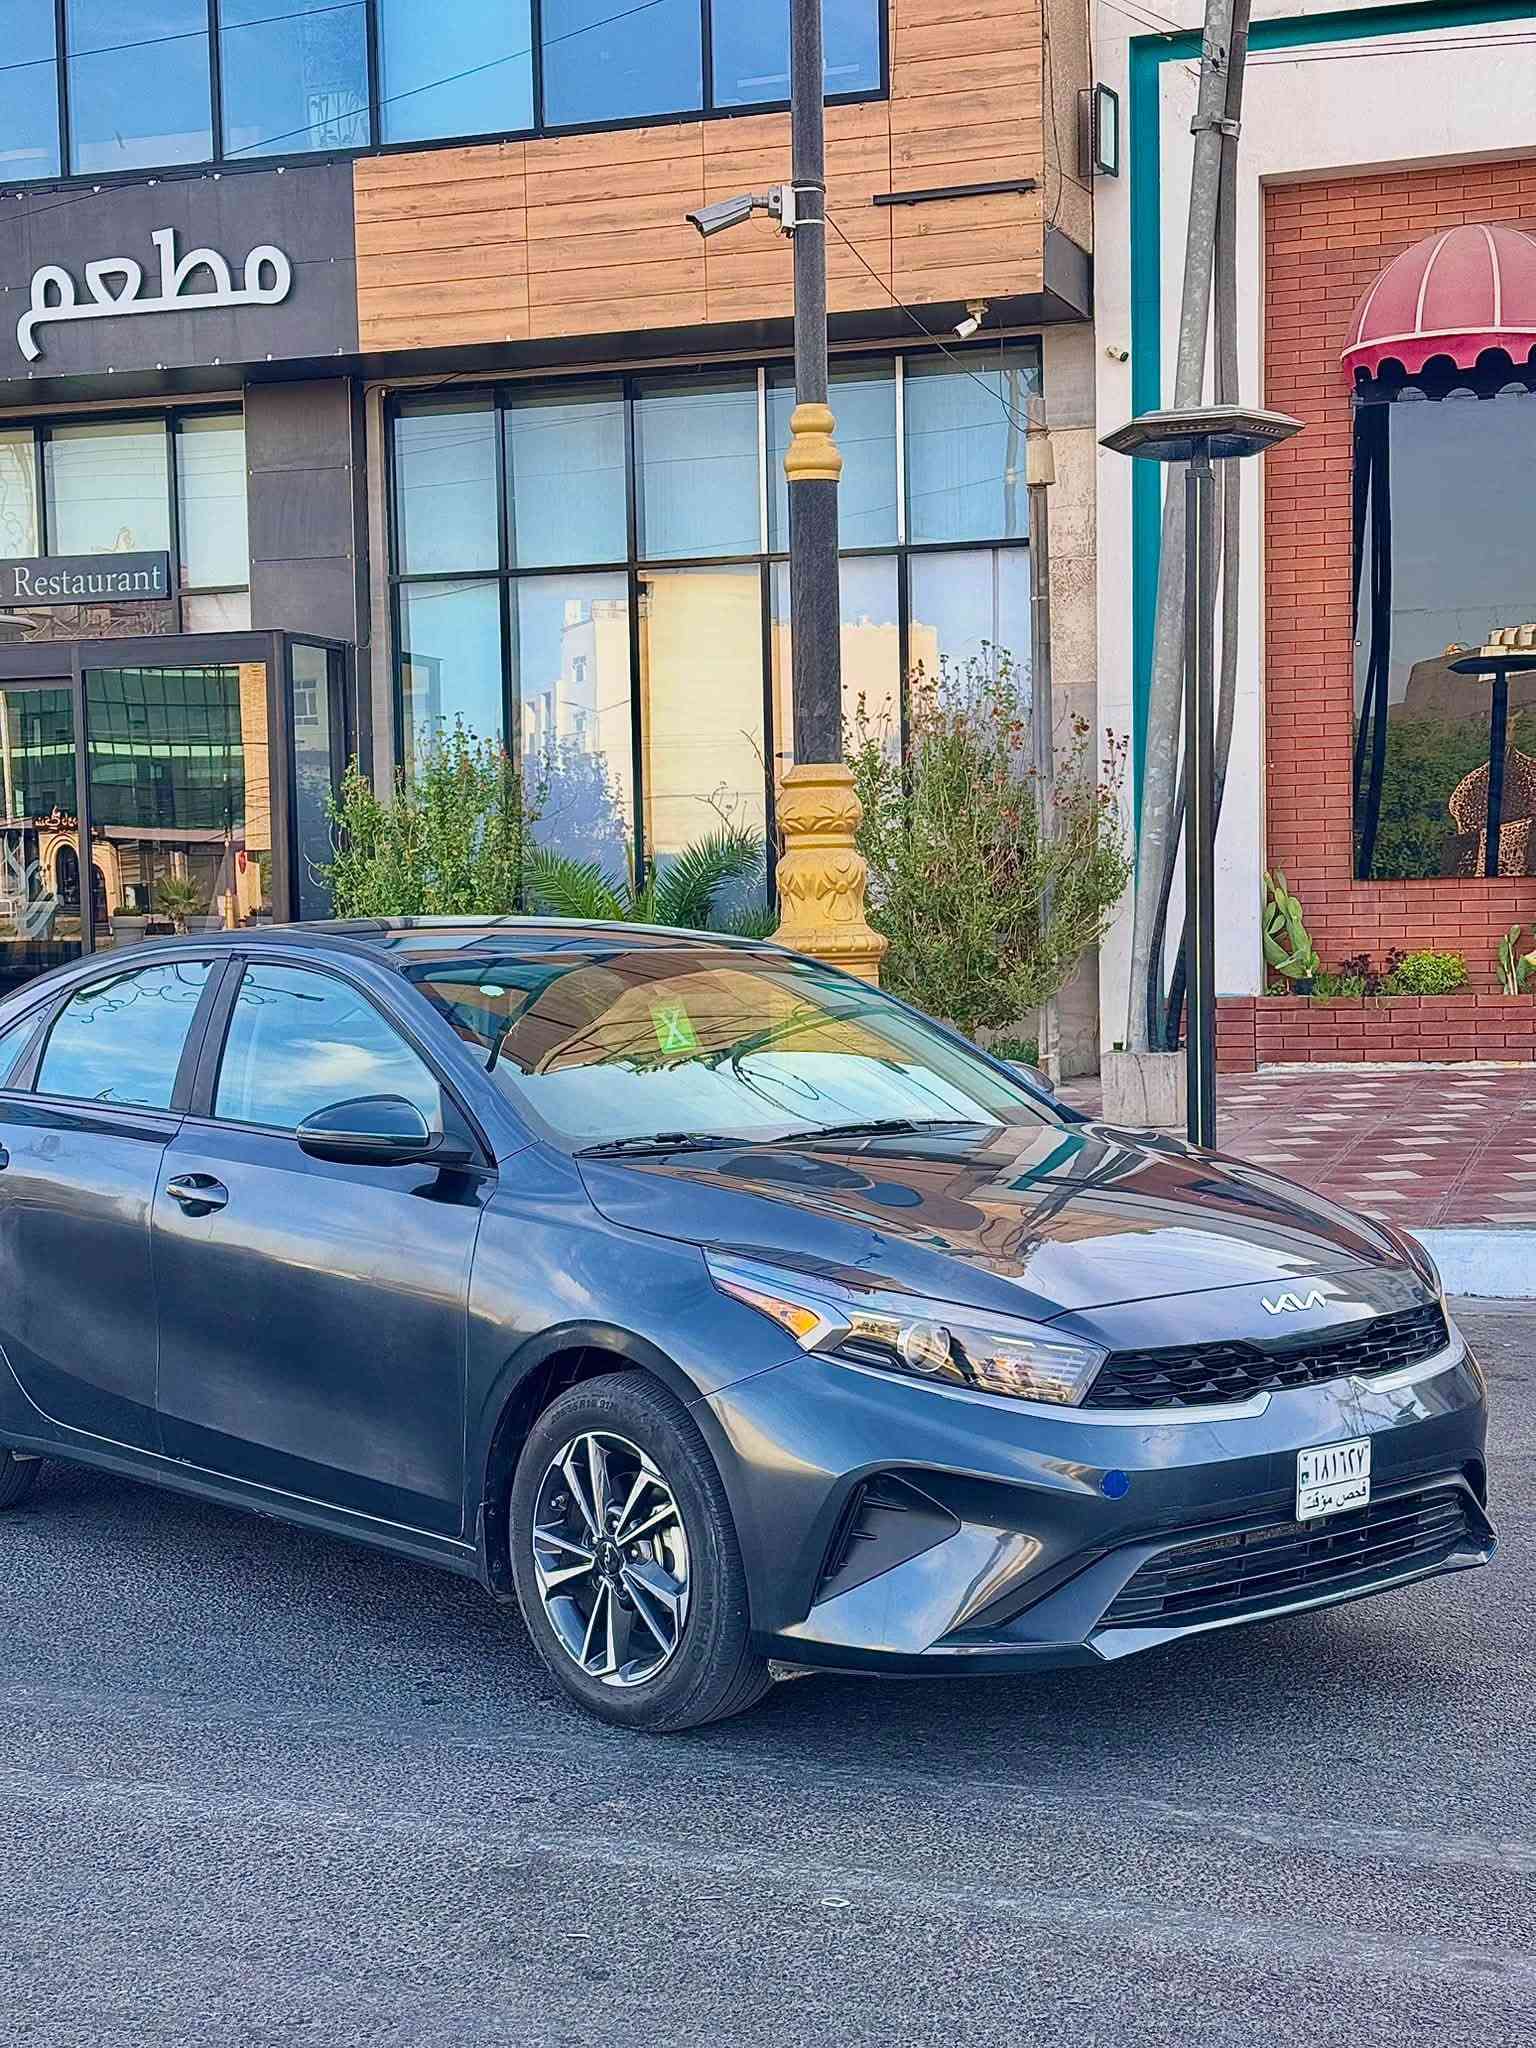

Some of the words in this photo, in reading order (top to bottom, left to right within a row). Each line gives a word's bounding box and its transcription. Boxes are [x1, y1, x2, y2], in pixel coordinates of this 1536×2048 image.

[16, 227, 292, 362] مطعم
[14, 565, 161, 597] Restaurant
[1336, 1481, 1367, 1507] فحص
